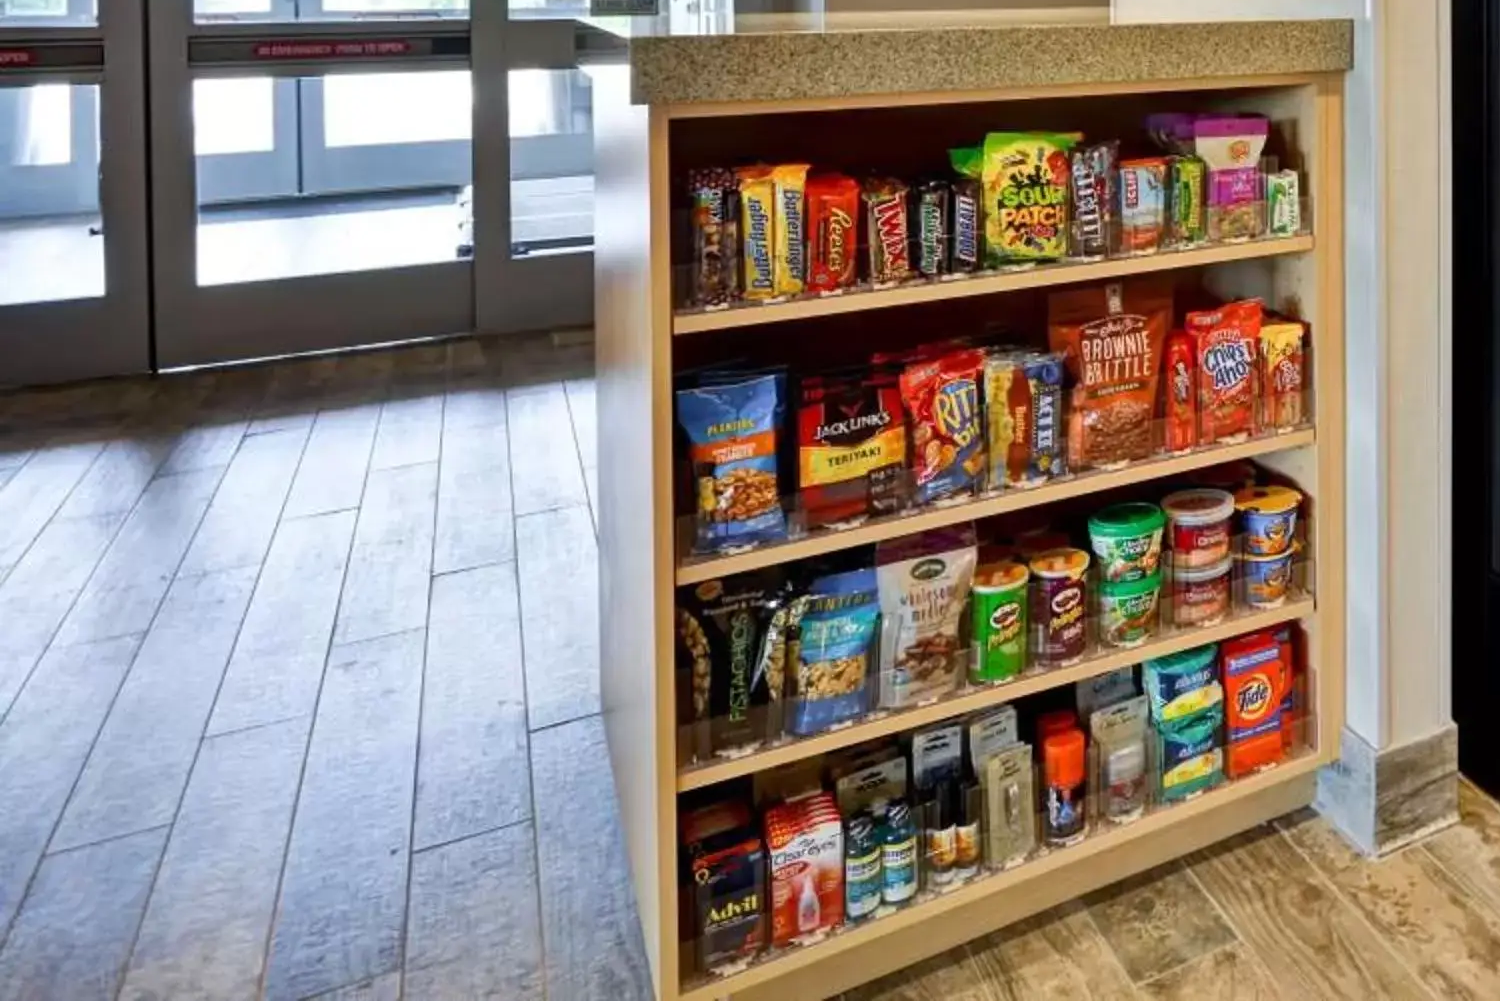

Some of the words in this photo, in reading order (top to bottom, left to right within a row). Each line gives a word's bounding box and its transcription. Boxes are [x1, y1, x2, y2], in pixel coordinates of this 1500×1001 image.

[1000, 205, 1065, 230] PATCH
[747, 197, 773, 288] Butterfinger
[1082, 330, 1152, 362] BROWNIE
[1085, 352, 1152, 386] BRITTLE
[814, 420, 850, 440] JACK
[849, 410, 890, 430] LINK'S
[828, 447, 881, 467] TERIYAKI
[730, 613, 748, 721] PISTACHIOS
[1240, 681, 1269, 712] Tide
[710, 894, 758, 922] Advil
